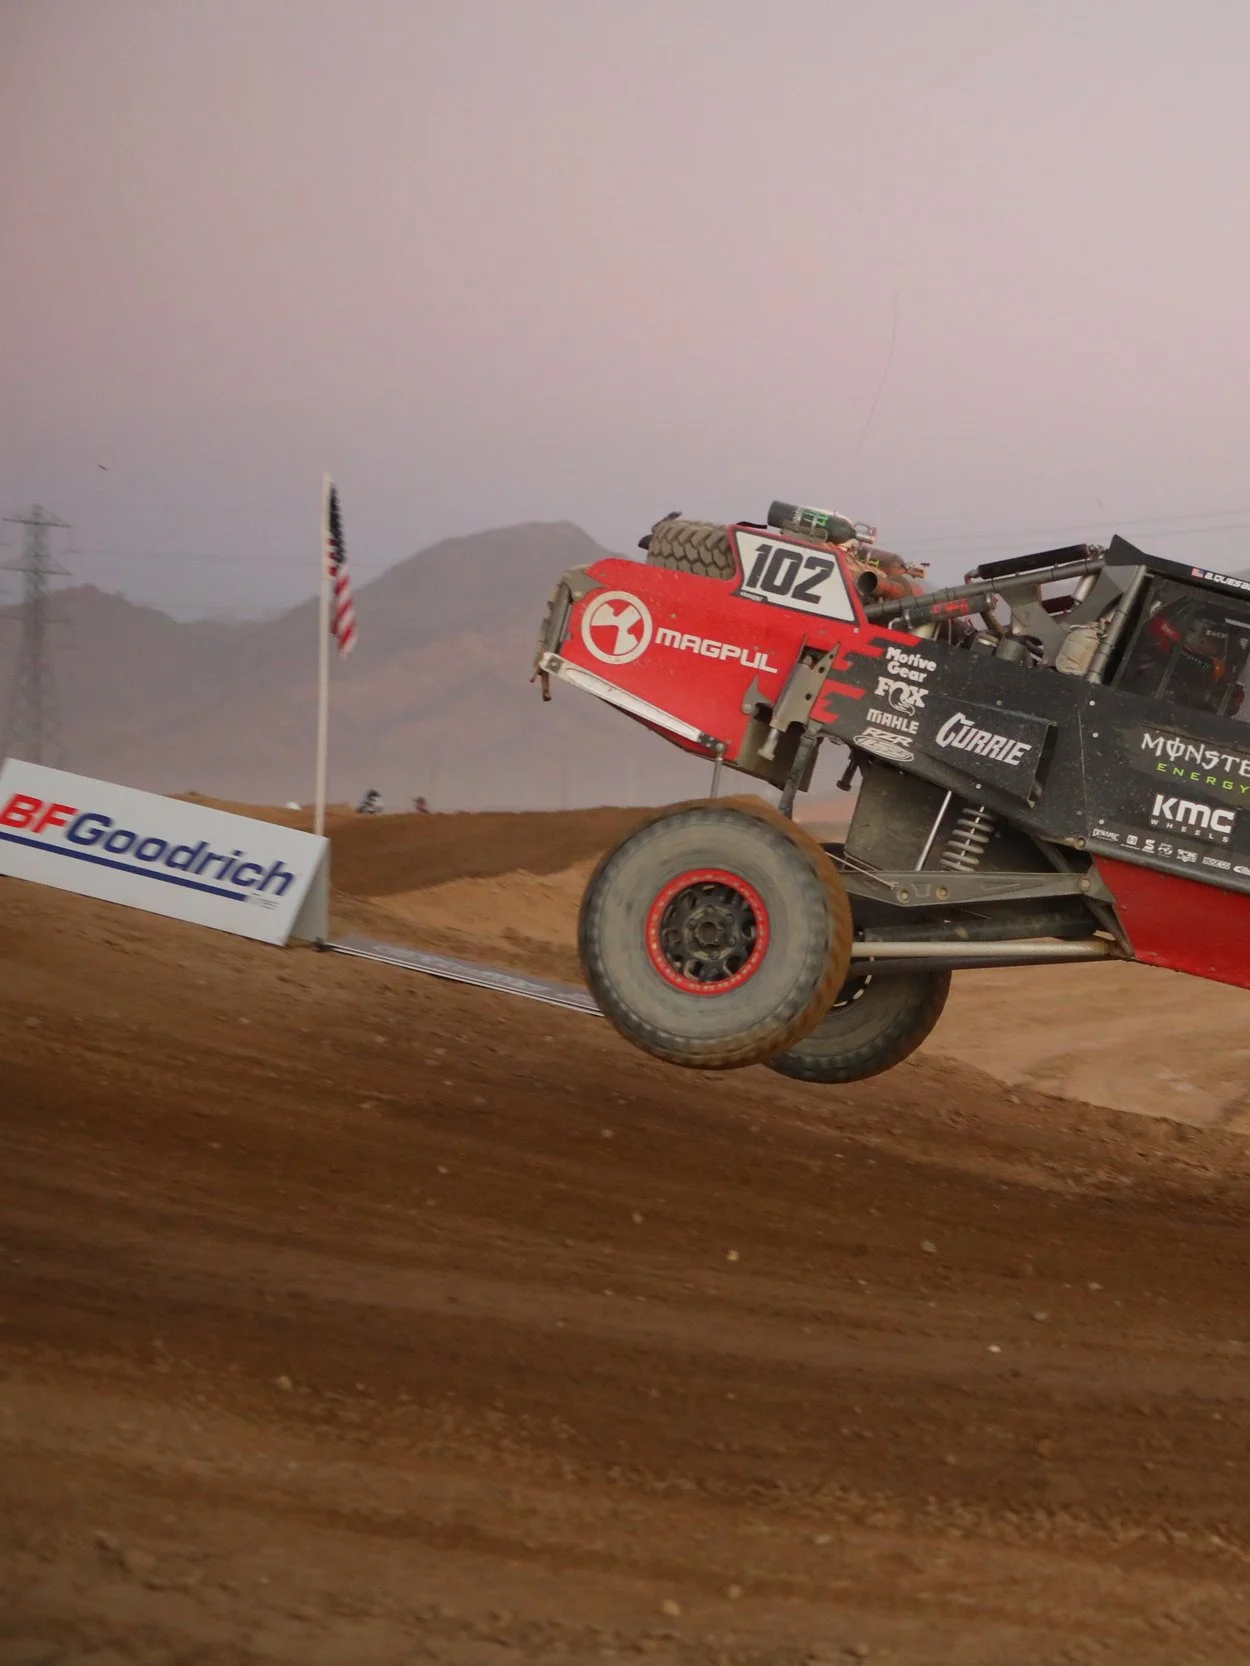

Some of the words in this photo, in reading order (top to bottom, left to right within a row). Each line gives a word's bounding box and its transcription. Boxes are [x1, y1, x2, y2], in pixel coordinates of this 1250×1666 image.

[746, 543, 835, 605] 102
[655, 627, 778, 674] MAGPUL
[886, 646, 937, 673] Motive
[887, 661, 928, 684] Gear
[874, 676, 930, 712] FOX
[862, 726, 913, 748] RZR
[866, 708, 920, 735] MAHLE
[935, 712, 1032, 766] CURRIE
[1156, 762, 1250, 794] ENERGY
[1150, 818, 1230, 843] WHEELS
[1151, 794, 1236, 834] KMC
[0, 793, 296, 896] BFGoodrich
